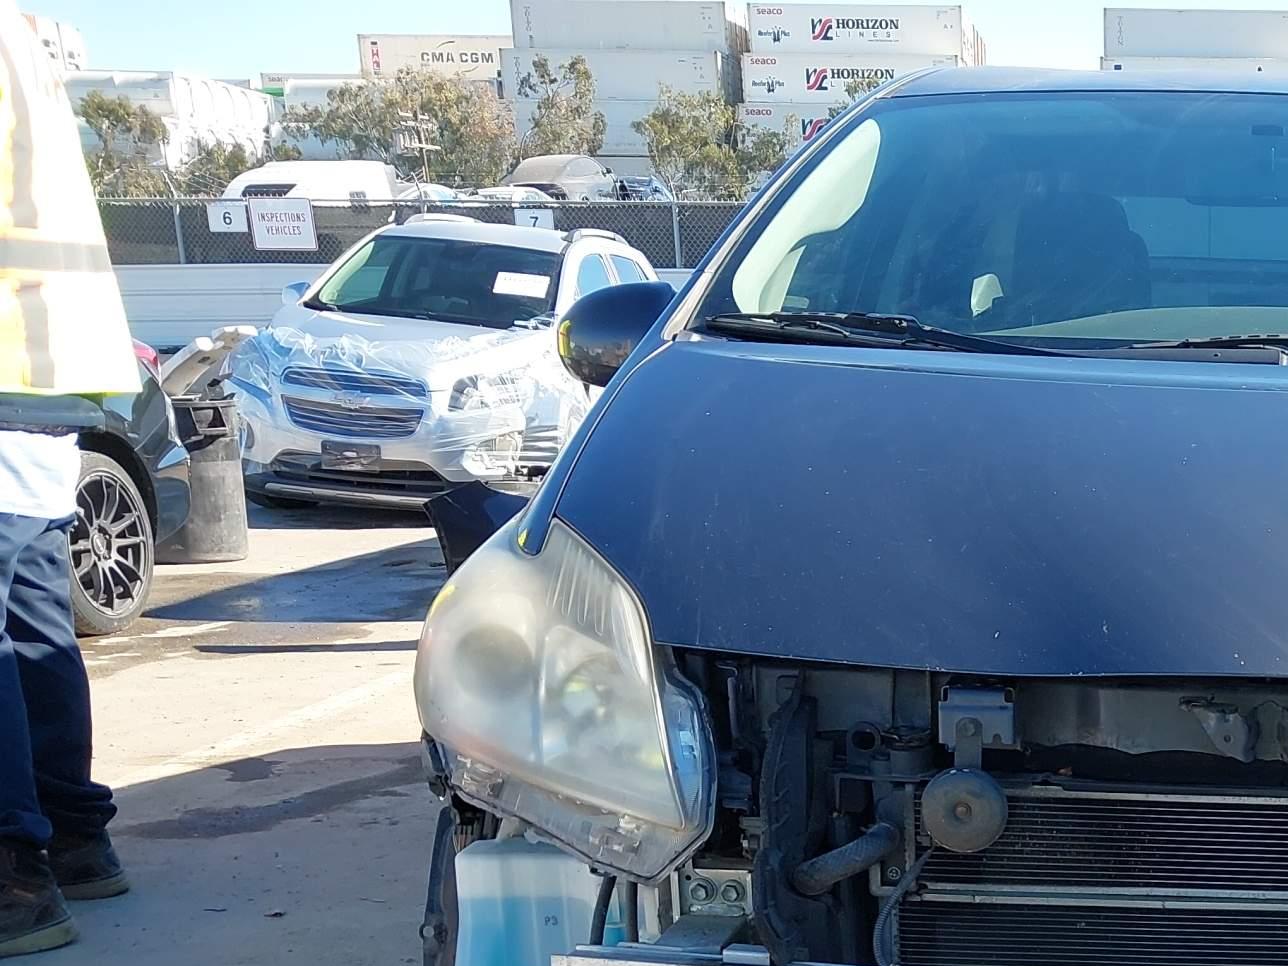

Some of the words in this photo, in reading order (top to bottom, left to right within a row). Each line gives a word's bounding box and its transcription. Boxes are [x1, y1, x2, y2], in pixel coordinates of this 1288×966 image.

[756, 7, 783, 16] seaco
[836, 19, 900, 30] HORIZON
[420, 51, 456, 64] CMA
[460, 51, 495, 64] CGM
[749, 57, 777, 66] seaco
[830, 68, 895, 80] HORIZON
[744, 107, 773, 116] seaco
[222, 211, 233, 226] 6
[257, 212, 306, 223] INSPECTIONS
[529, 215, 539, 228] 7
[265, 225, 302, 236] VEHICLES
